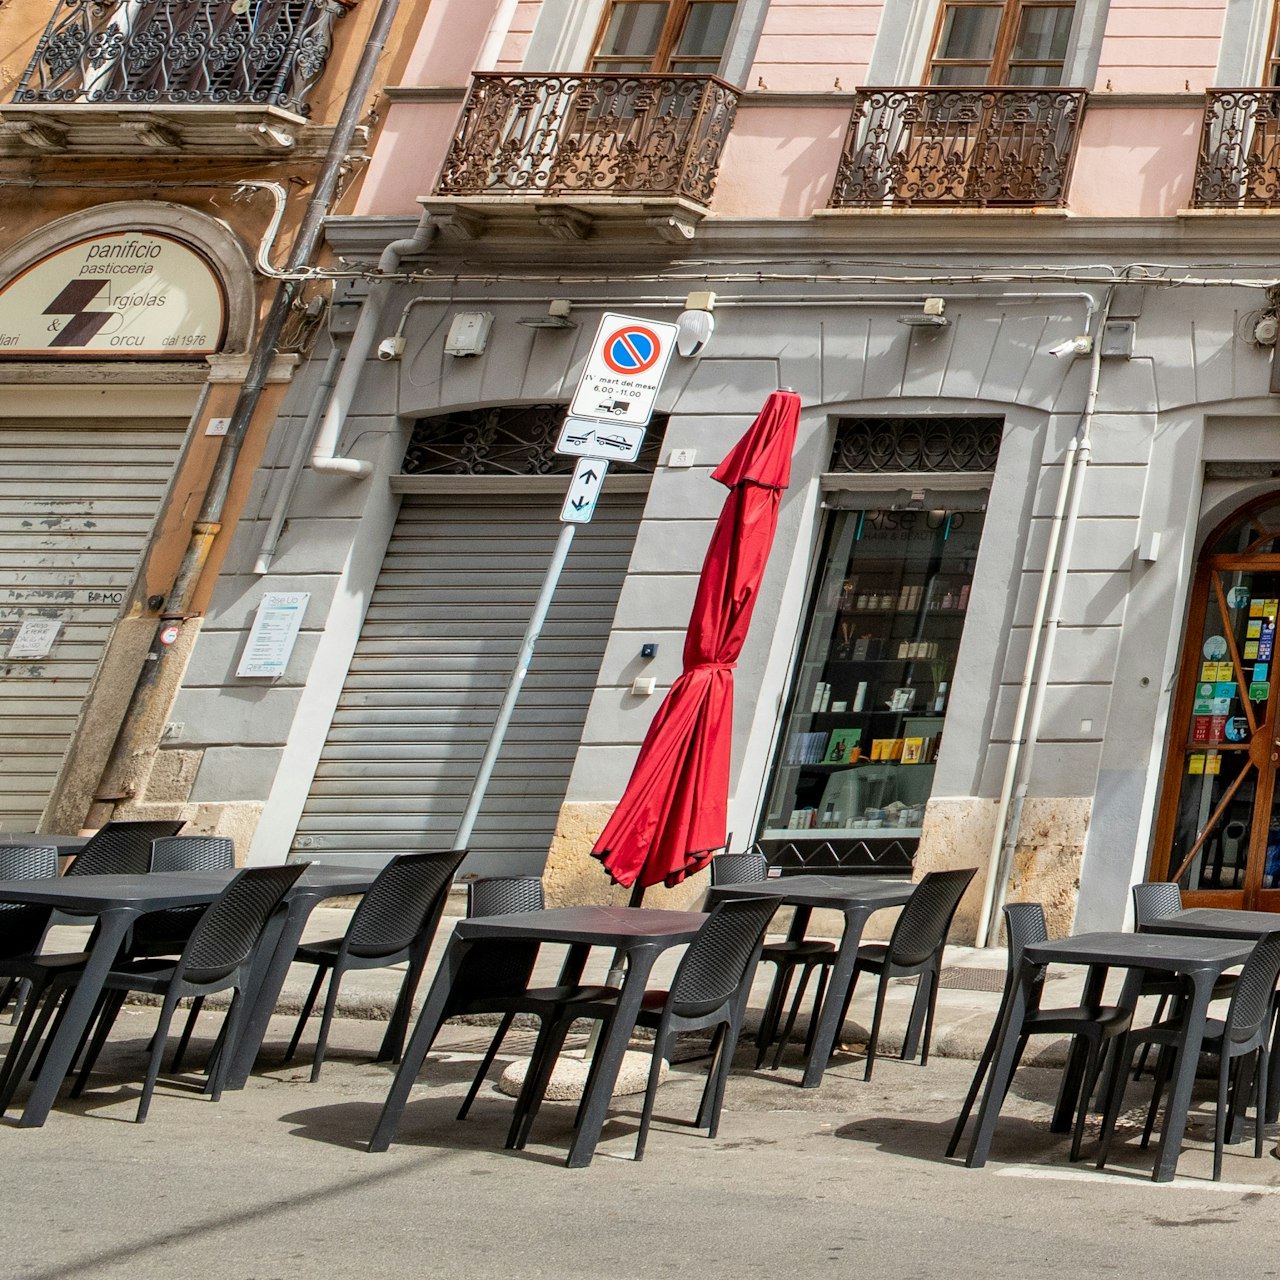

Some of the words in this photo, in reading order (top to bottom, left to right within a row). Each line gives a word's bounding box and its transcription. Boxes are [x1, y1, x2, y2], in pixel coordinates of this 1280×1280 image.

[86, 240, 162, 262] panificio
[79, 263, 154, 276] pasticceria
[81, 279, 167, 310] Argiolas
[47, 318, 61, 332] &
[161, 335, 178, 346] dal
[181, 335, 207, 346] 1976
[599, 376, 619, 386] mart
[621, 380, 634, 388] del
[863, 532, 888, 541] HAIR
